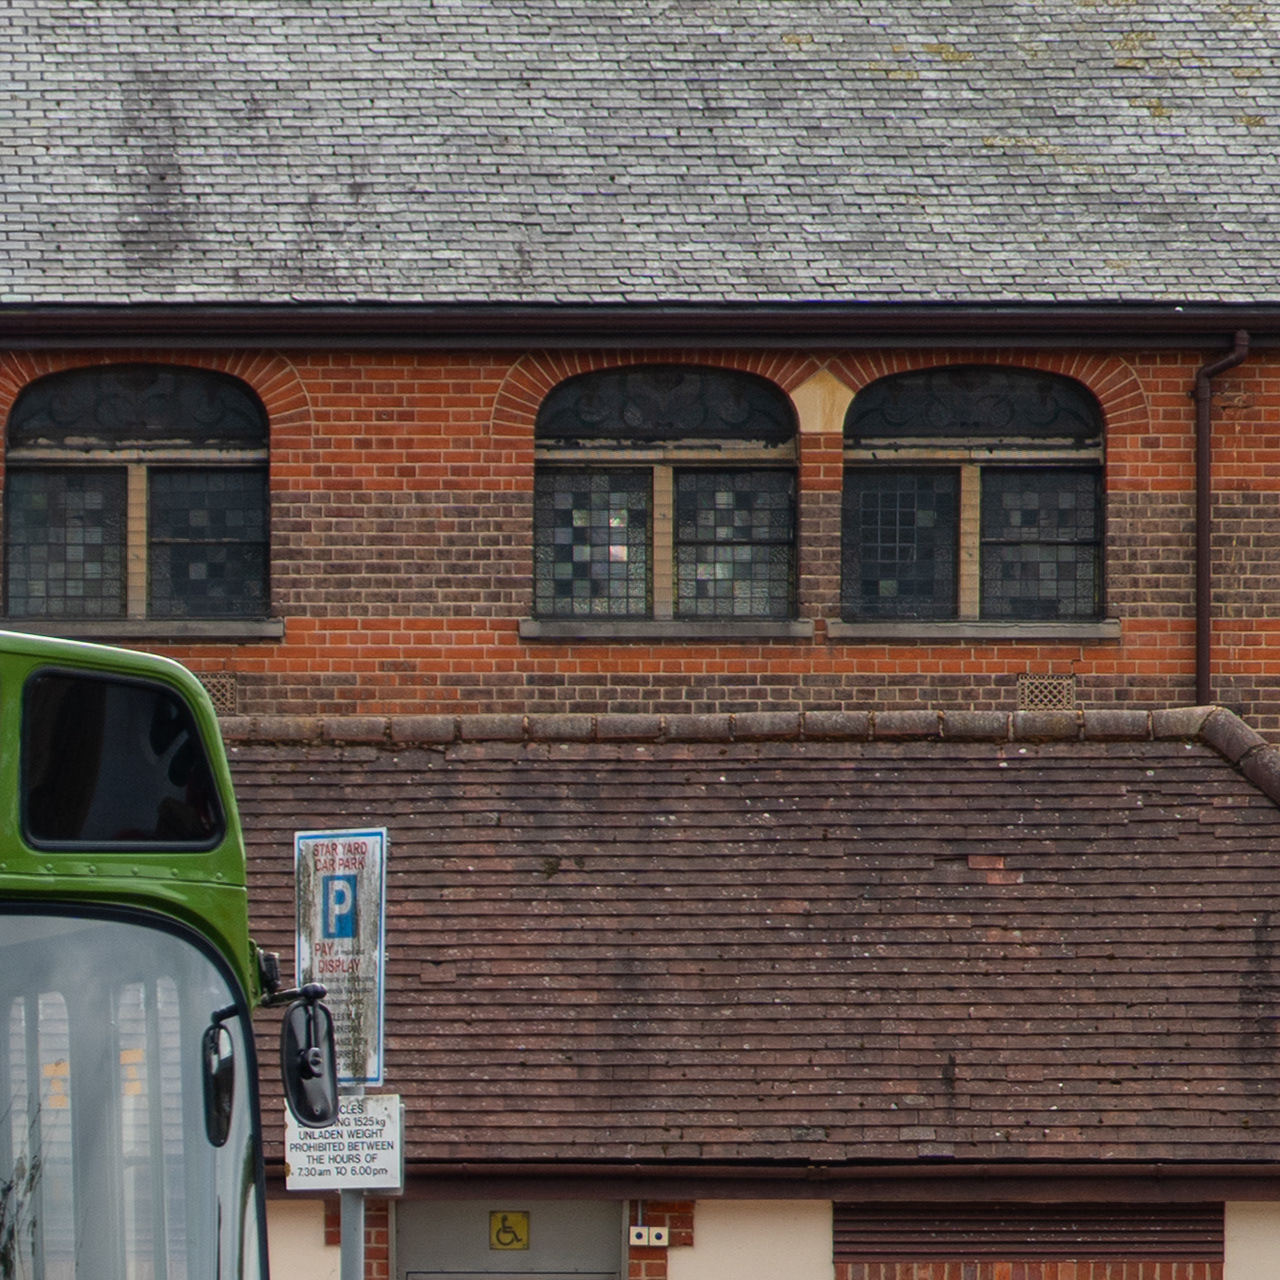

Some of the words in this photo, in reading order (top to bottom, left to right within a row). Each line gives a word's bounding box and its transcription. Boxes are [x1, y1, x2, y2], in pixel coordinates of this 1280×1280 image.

[313, 842, 338, 857] STAR
[342, 841, 367, 854] YARD
[315, 859, 336, 871] CAR
[338, 857, 365, 870] PARK
[328, 880, 352, 934] P
[315, 942, 335, 956] PAY
[319, 959, 360, 973] DISPLAY
[339, 1104, 364, 1114] CLES
[298, 1130, 343, 1140] UNLADEN
[347, 1128, 384, 1138] WEIGHT
[289, 1142, 345, 1152] PROHIBITED
[347, 1141, 394, 1151] BETWEEN
[306, 1155, 324, 1164] THE
[328, 1154, 361, 1164] HOURS
[364, 1153, 378, 1163] OF
[335, 1166, 347, 1176] TO
